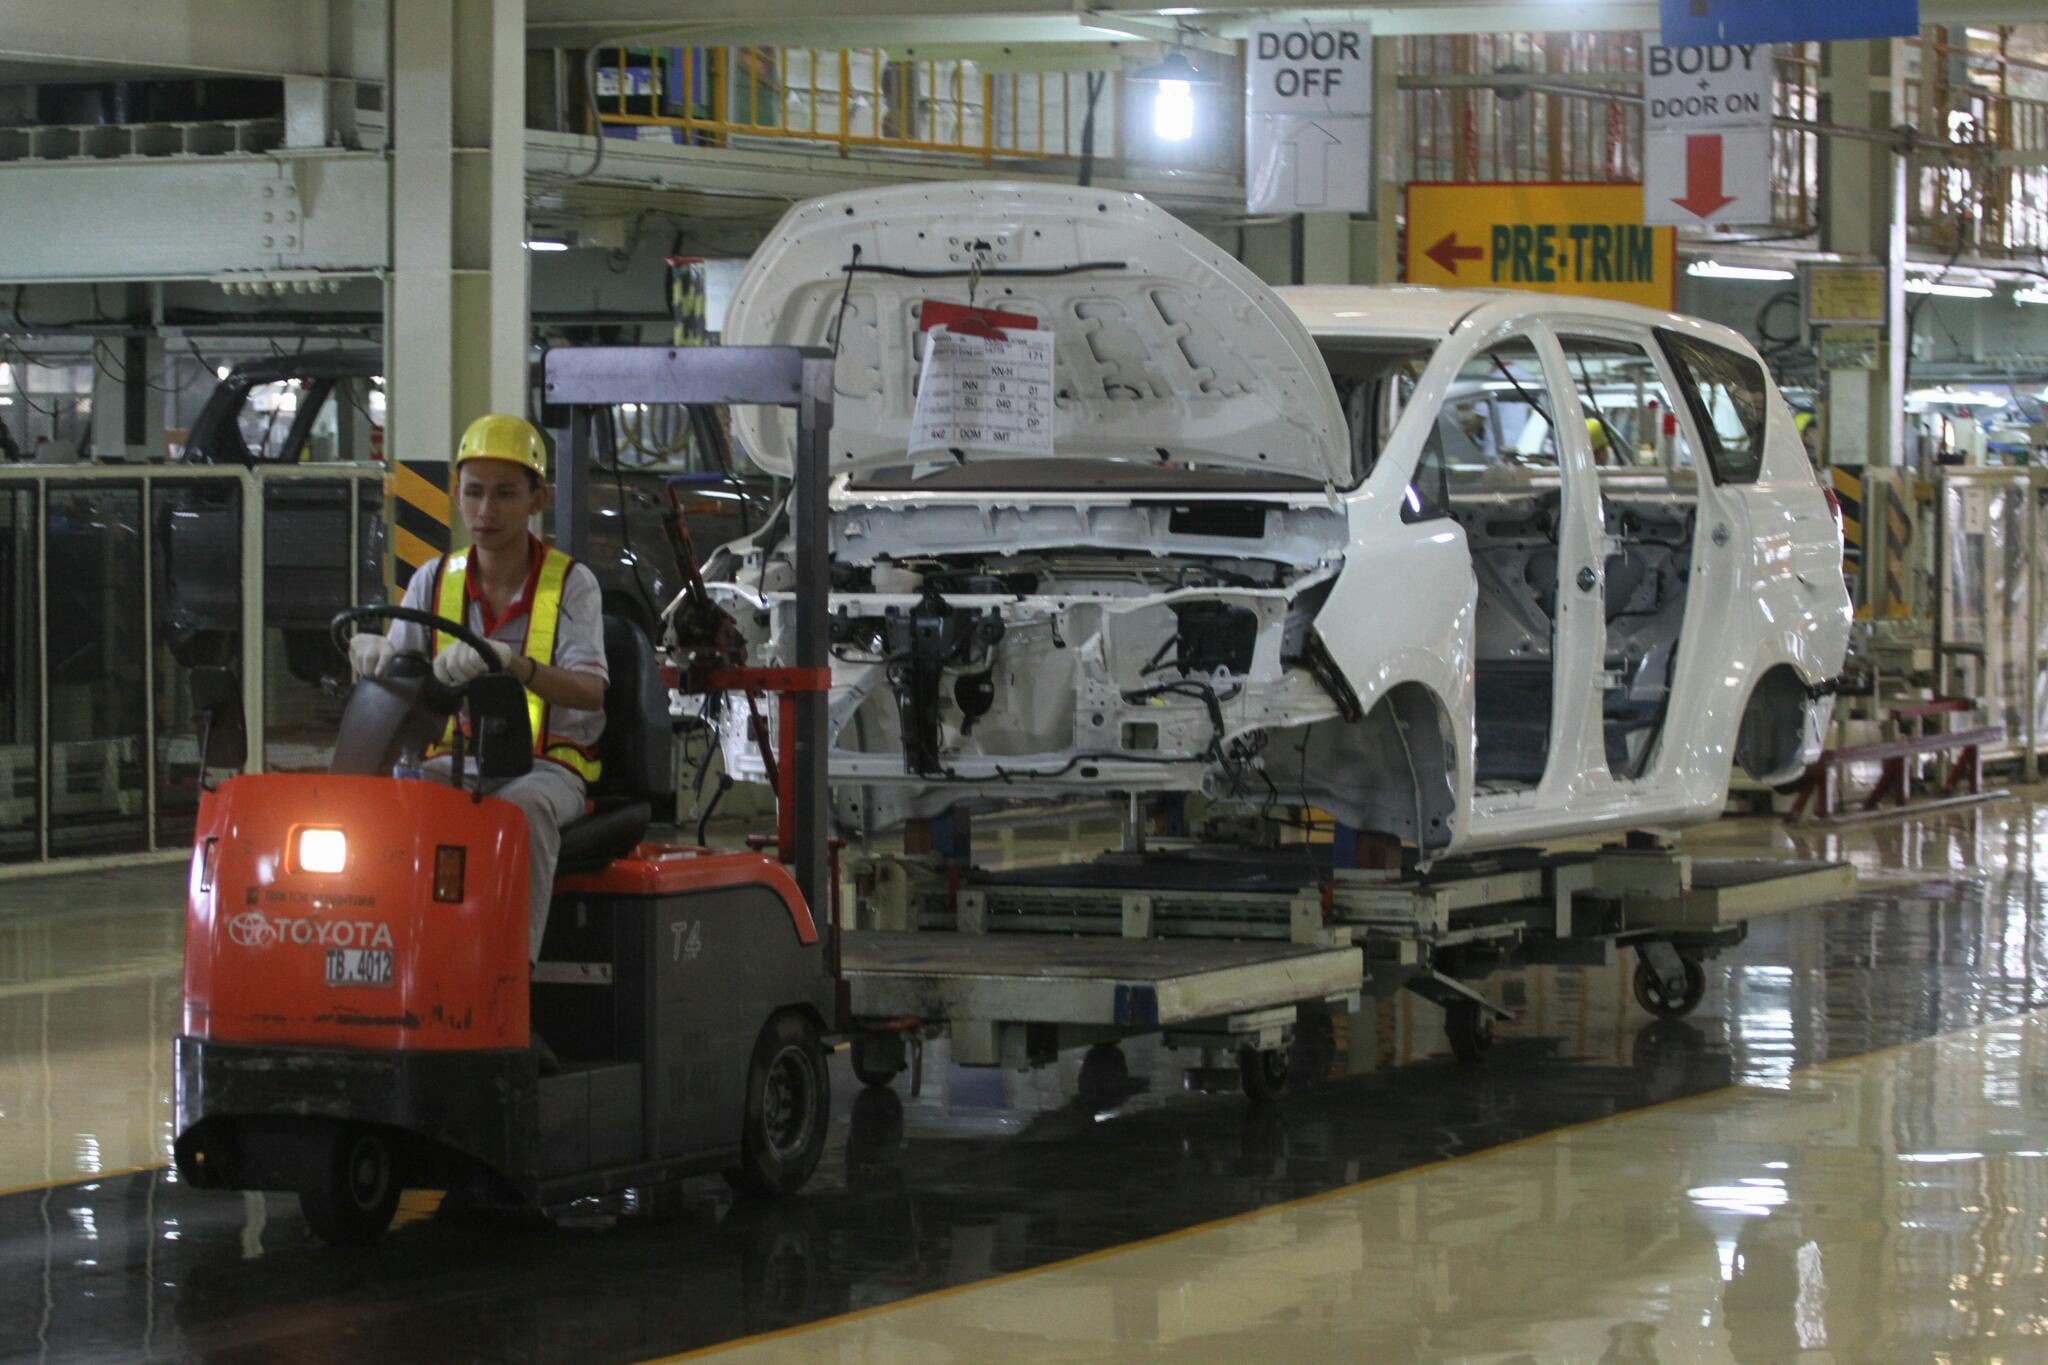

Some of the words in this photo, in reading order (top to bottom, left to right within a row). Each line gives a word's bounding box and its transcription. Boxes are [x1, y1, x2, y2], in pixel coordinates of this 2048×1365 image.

[1258, 31, 1360, 61] DOOR
[1649, 44, 1757, 76] BODY
[1275, 68, 1343, 97] OFF
[1651, 96, 1719, 118] DOOR
[1725, 93, 1760, 114] ON
[1491, 224, 1654, 283] PRE-TRIM
[274, 917, 394, 949] TOYOTA
